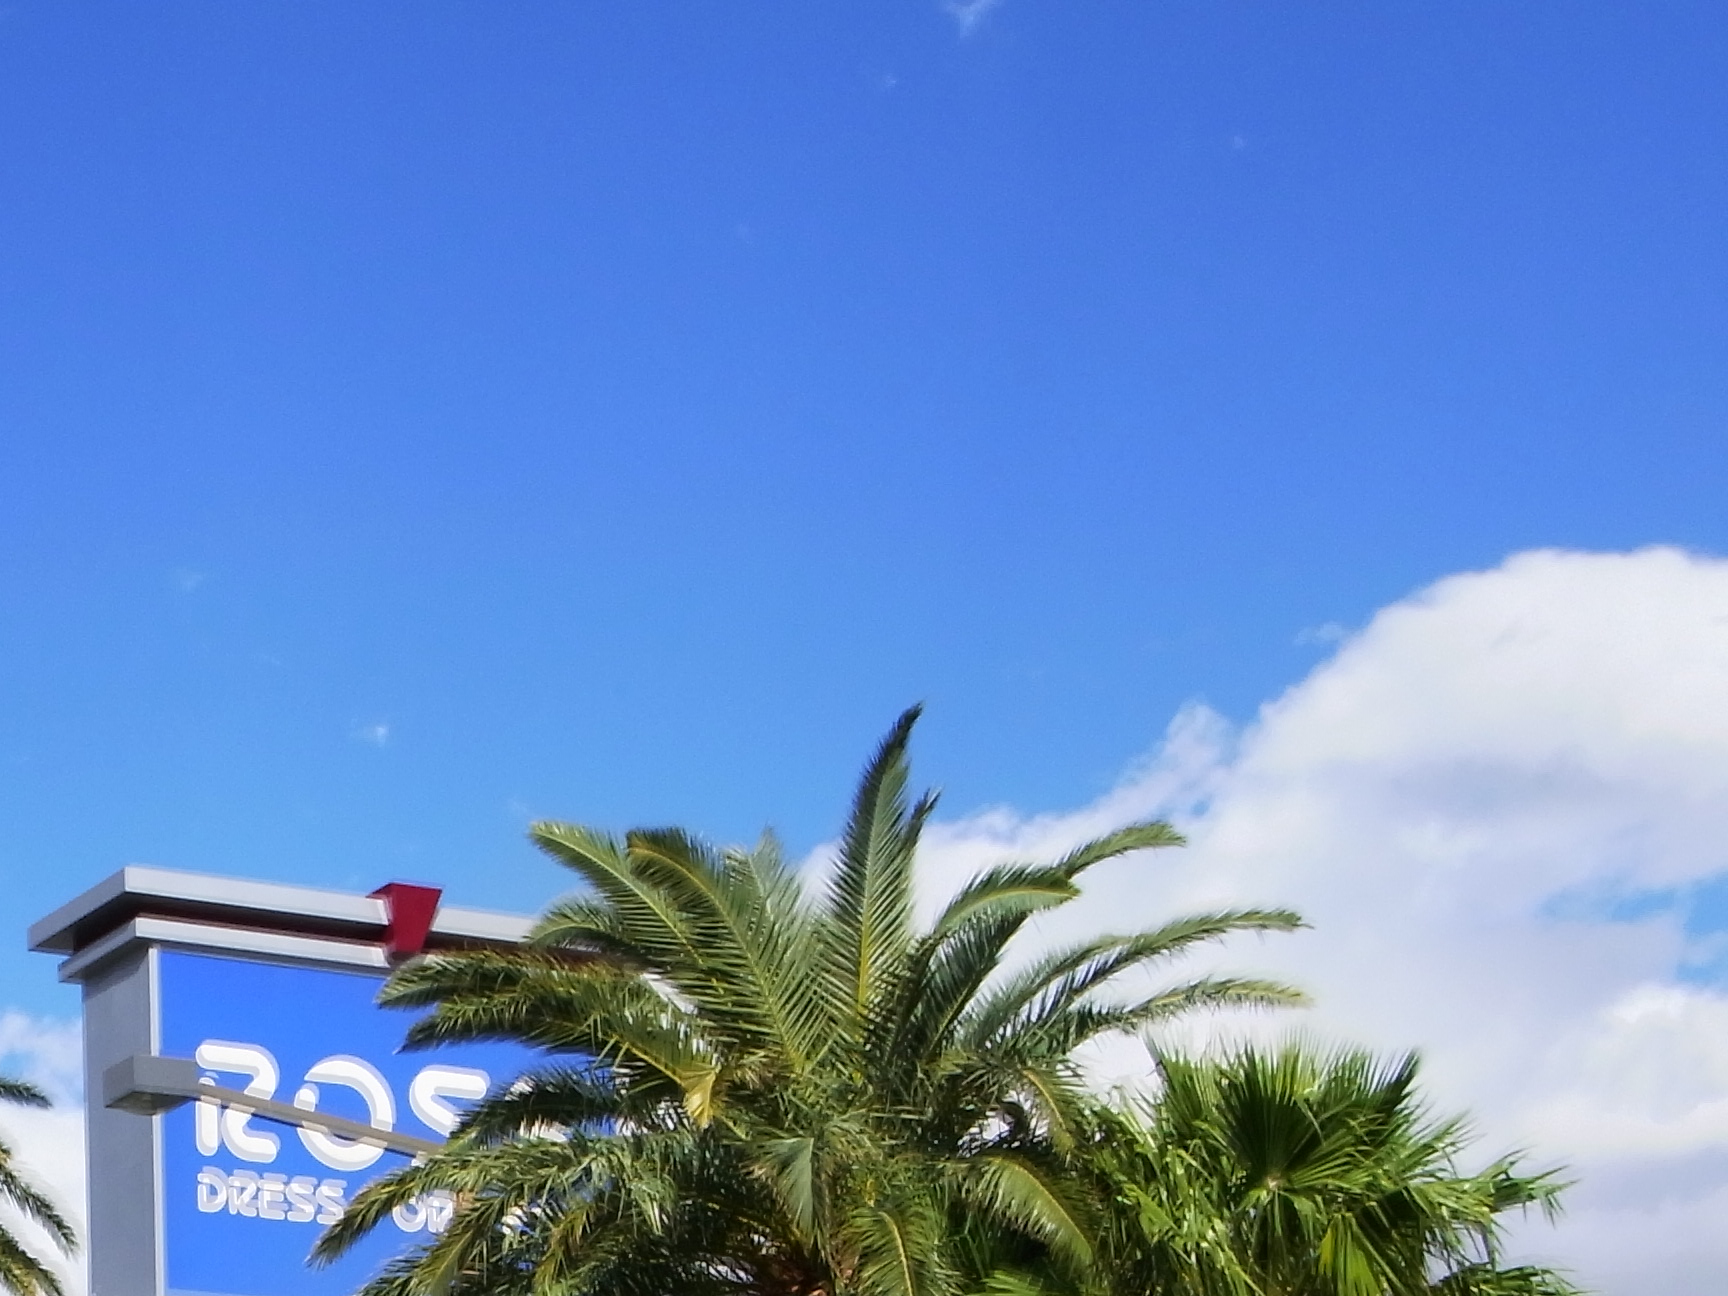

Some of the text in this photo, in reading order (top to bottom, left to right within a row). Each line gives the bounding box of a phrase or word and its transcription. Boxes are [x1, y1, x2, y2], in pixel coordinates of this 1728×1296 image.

[195, 1040, 557, 1172] ROS
[197, 1168, 346, 1224] DRESS
[392, 1191, 456, 1233] OR
